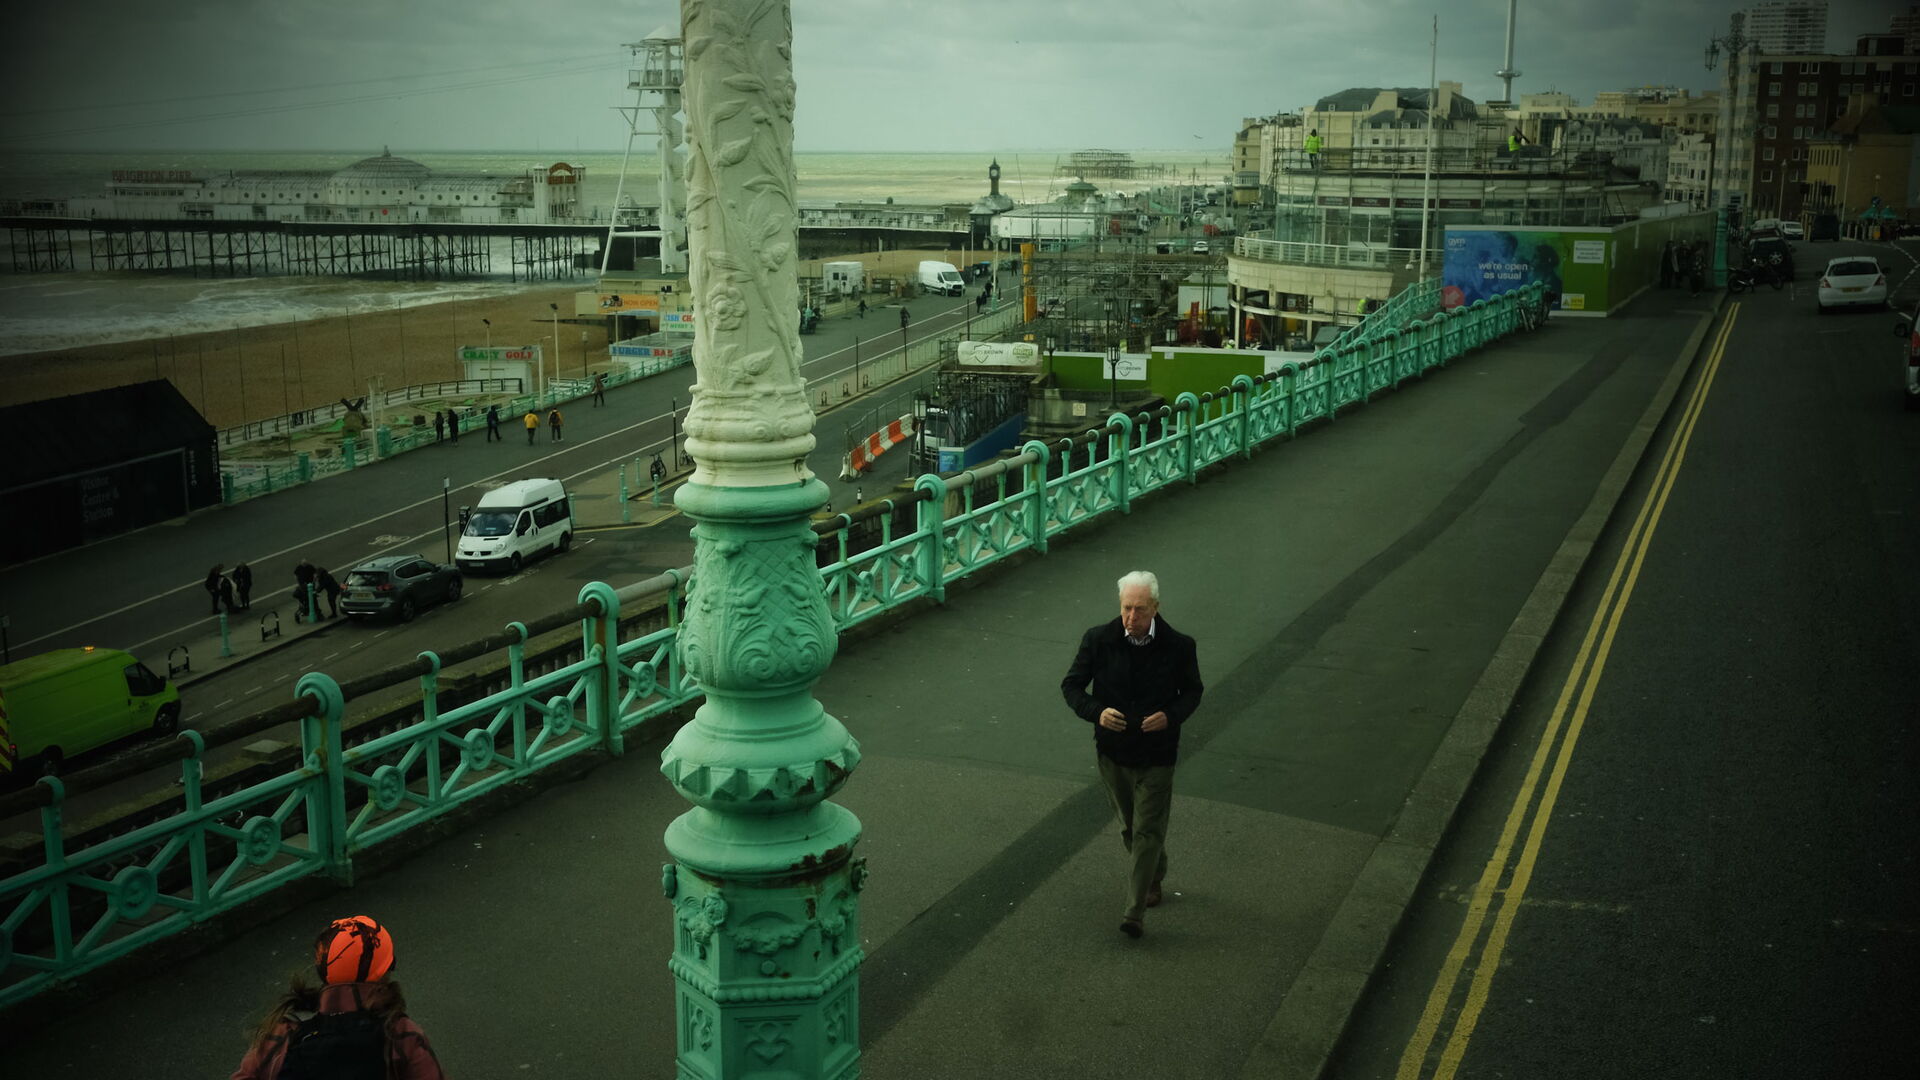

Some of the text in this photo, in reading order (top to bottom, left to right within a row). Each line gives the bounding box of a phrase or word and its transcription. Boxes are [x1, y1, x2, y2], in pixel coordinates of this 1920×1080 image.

[168, 170, 192, 183] PIER
[1448, 238, 1465, 246] gym
[1478, 262, 1528, 272] we're open
[1497, 272, 1522, 280] usual
[506, 351, 533, 359] GOLF
